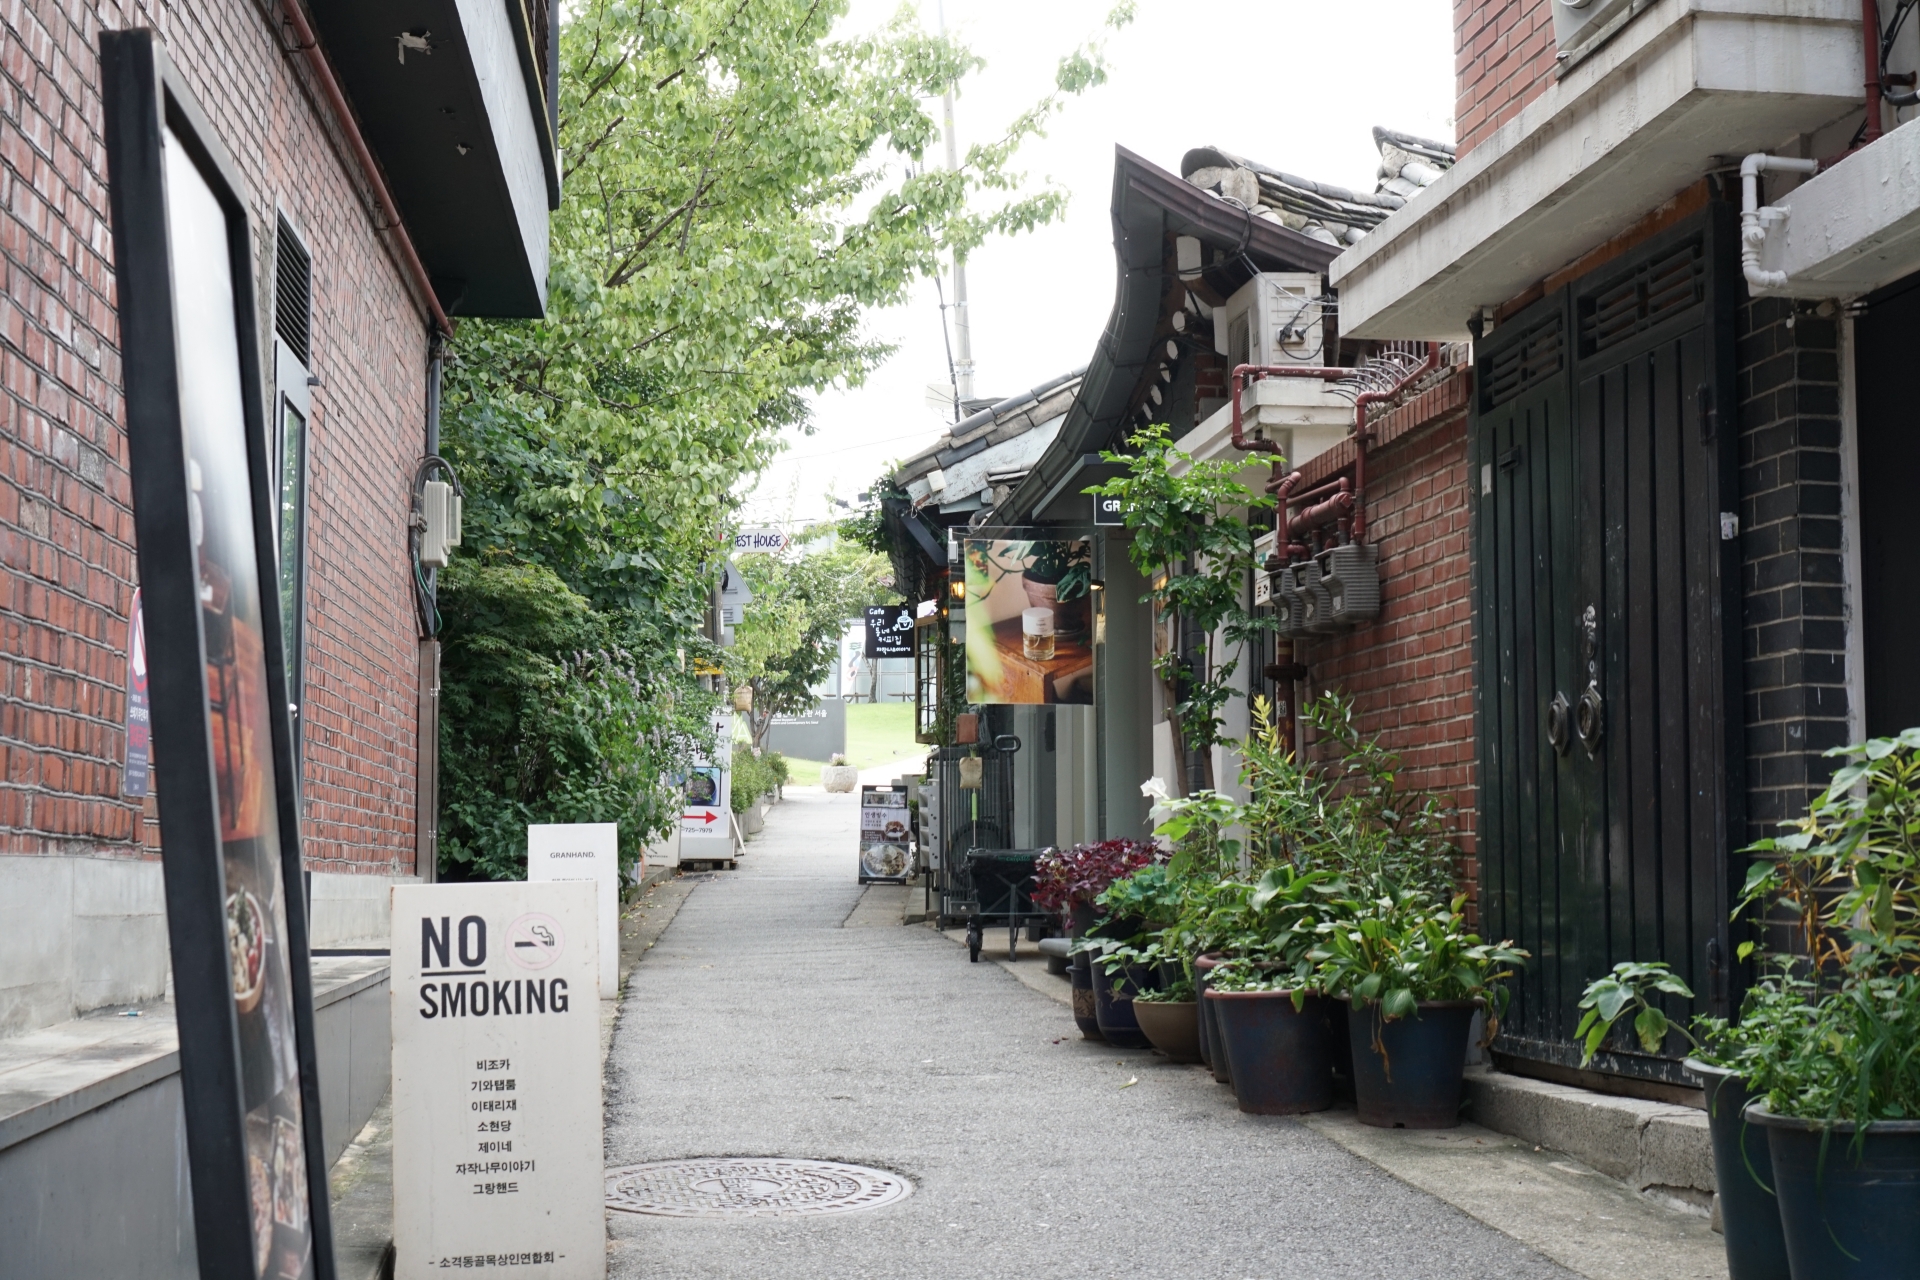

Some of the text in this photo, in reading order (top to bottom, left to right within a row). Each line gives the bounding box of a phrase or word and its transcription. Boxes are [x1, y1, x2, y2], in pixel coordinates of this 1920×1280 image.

[753, 532, 782, 549] HOUSE
[869, 618, 885, 628] 우리
[875, 627, 890, 637] 동네
[877, 635, 902, 646] 커피집
[549, 851, 596, 859] GRANHAND.
[421, 915, 487, 968] NO
[419, 978, 569, 1019] SMOKING
[476, 1058, 511, 1071] 비조카
[471, 1078, 517, 1092] 기와탭룸
[471, 1099, 517, 1112] 이태리재
[477, 1119, 512, 1133] 소현당
[478, 1140, 512, 1153] 제이네
[455, 1160, 535, 1175] 자작나무이야기
[473, 1181, 519, 1195] 그랑핸드
[439, 1251, 555, 1269] 소격동골목상인연합회
